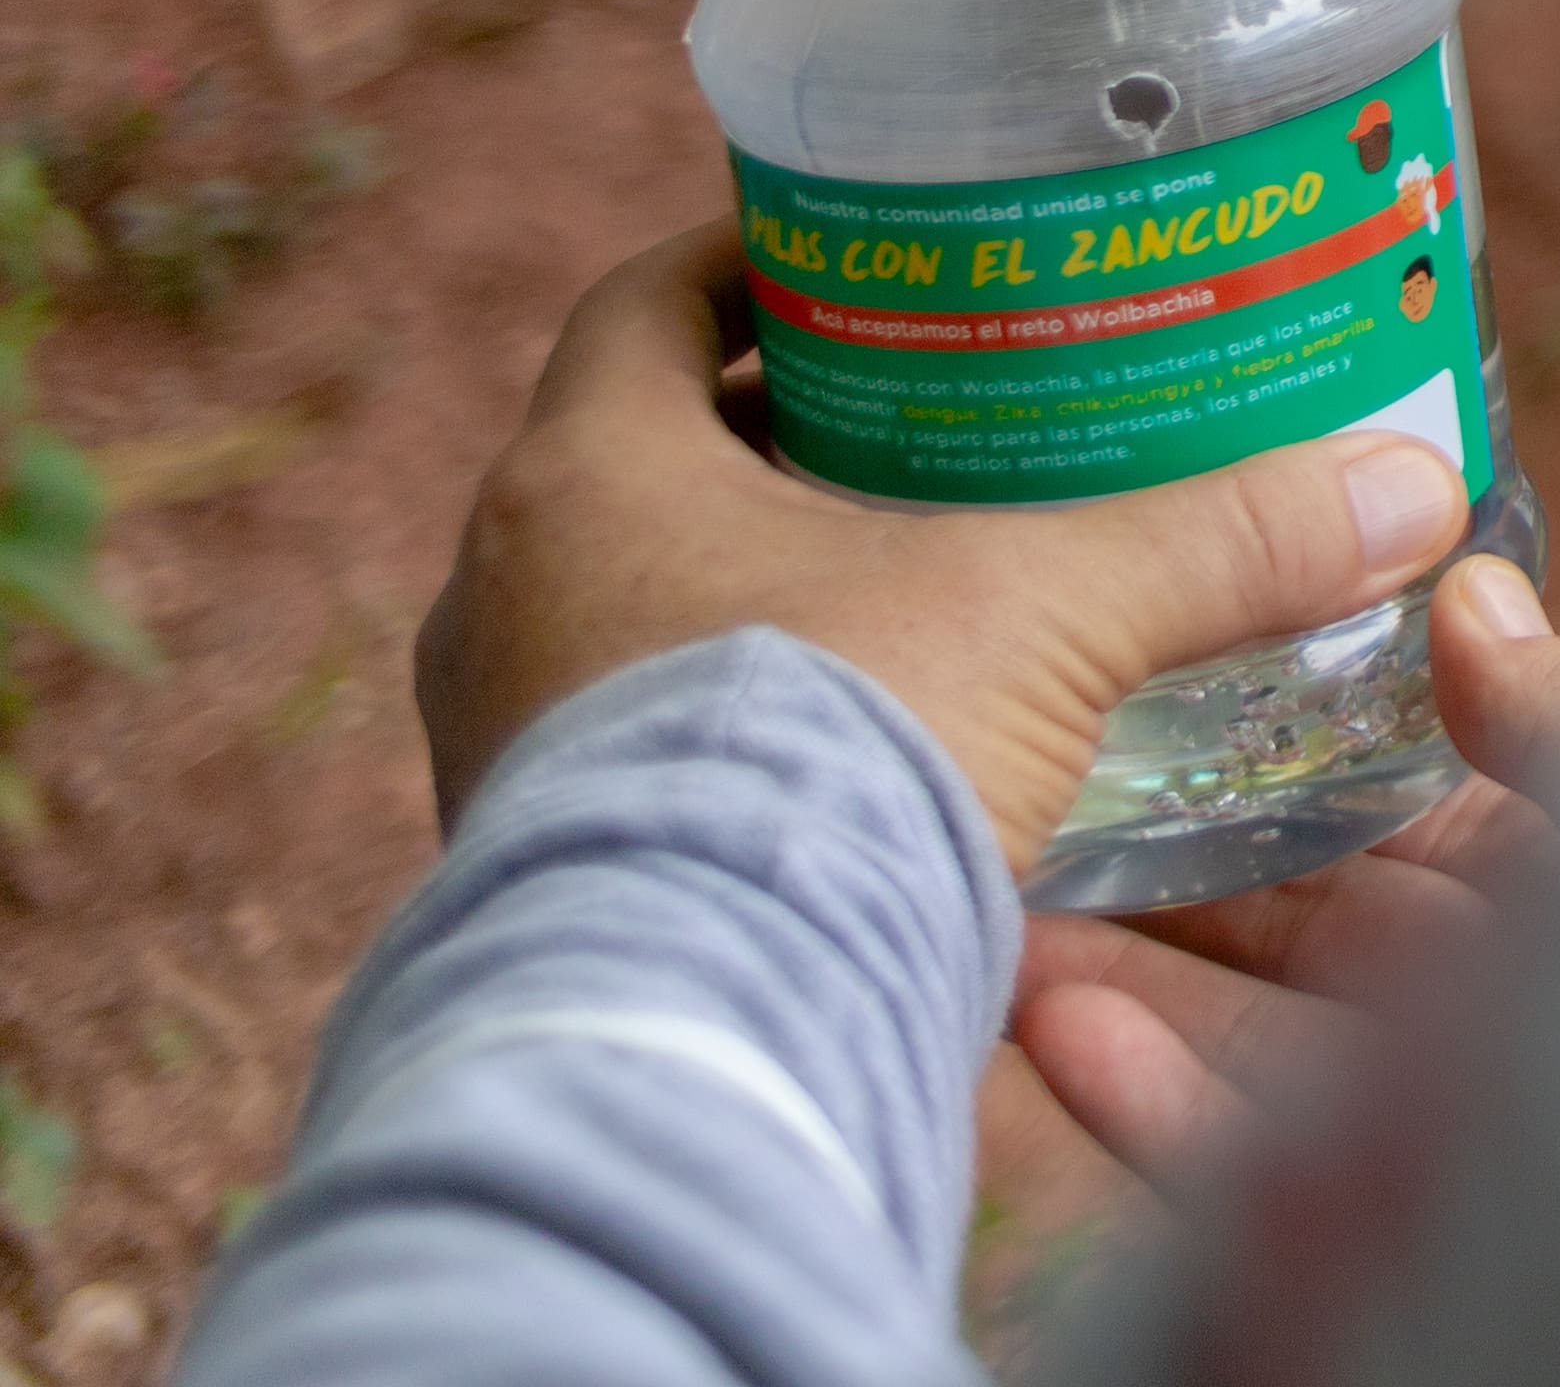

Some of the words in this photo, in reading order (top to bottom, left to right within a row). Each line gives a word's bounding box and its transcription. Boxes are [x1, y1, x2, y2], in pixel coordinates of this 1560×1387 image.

[794, 190, 870, 220] Nuestra
[877, 202, 1023, 224] comunidad
[1033, 193, 1107, 218] unida
[1115, 188, 1144, 205] se
[1152, 170, 1216, 202] pone
[840, 239, 942, 286] CON
[971, 237, 1037, 288] EL
[1060, 171, 1324, 278] ZANCUDO
[812, 306, 844, 329] Acá
[849, 317, 971, 340] aceptamos
[978, 319, 1002, 339] el
[1010, 316, 1065, 338] reto
[1071, 288, 1215, 331] Wolbachia
[1302, 317, 1375, 358] amarilla
[830, 369, 910, 394] zancudos
[916, 381, 953, 395] con
[961, 374, 1088, 395] Wolbachia,
[1095, 369, 1117, 386] la
[1124, 348, 1219, 381] bacteria
[1228, 334, 1265, 357] que
[1274, 322, 1302, 341] los
[1309, 301, 1353, 328] hace
[914, 428, 984, 449] seguro
[992, 430, 1041, 448] para
[1050, 425, 1079, 442] las
[1089, 407, 1201, 441] personas,
[1209, 393, 1240, 413] los
[1247, 361, 1335, 403] animales
[1343, 352, 1353, 370] y
[912, 453, 927, 469] el
[936, 453, 1012, 471] medios
[1020, 444, 1136, 469] ambiente.
